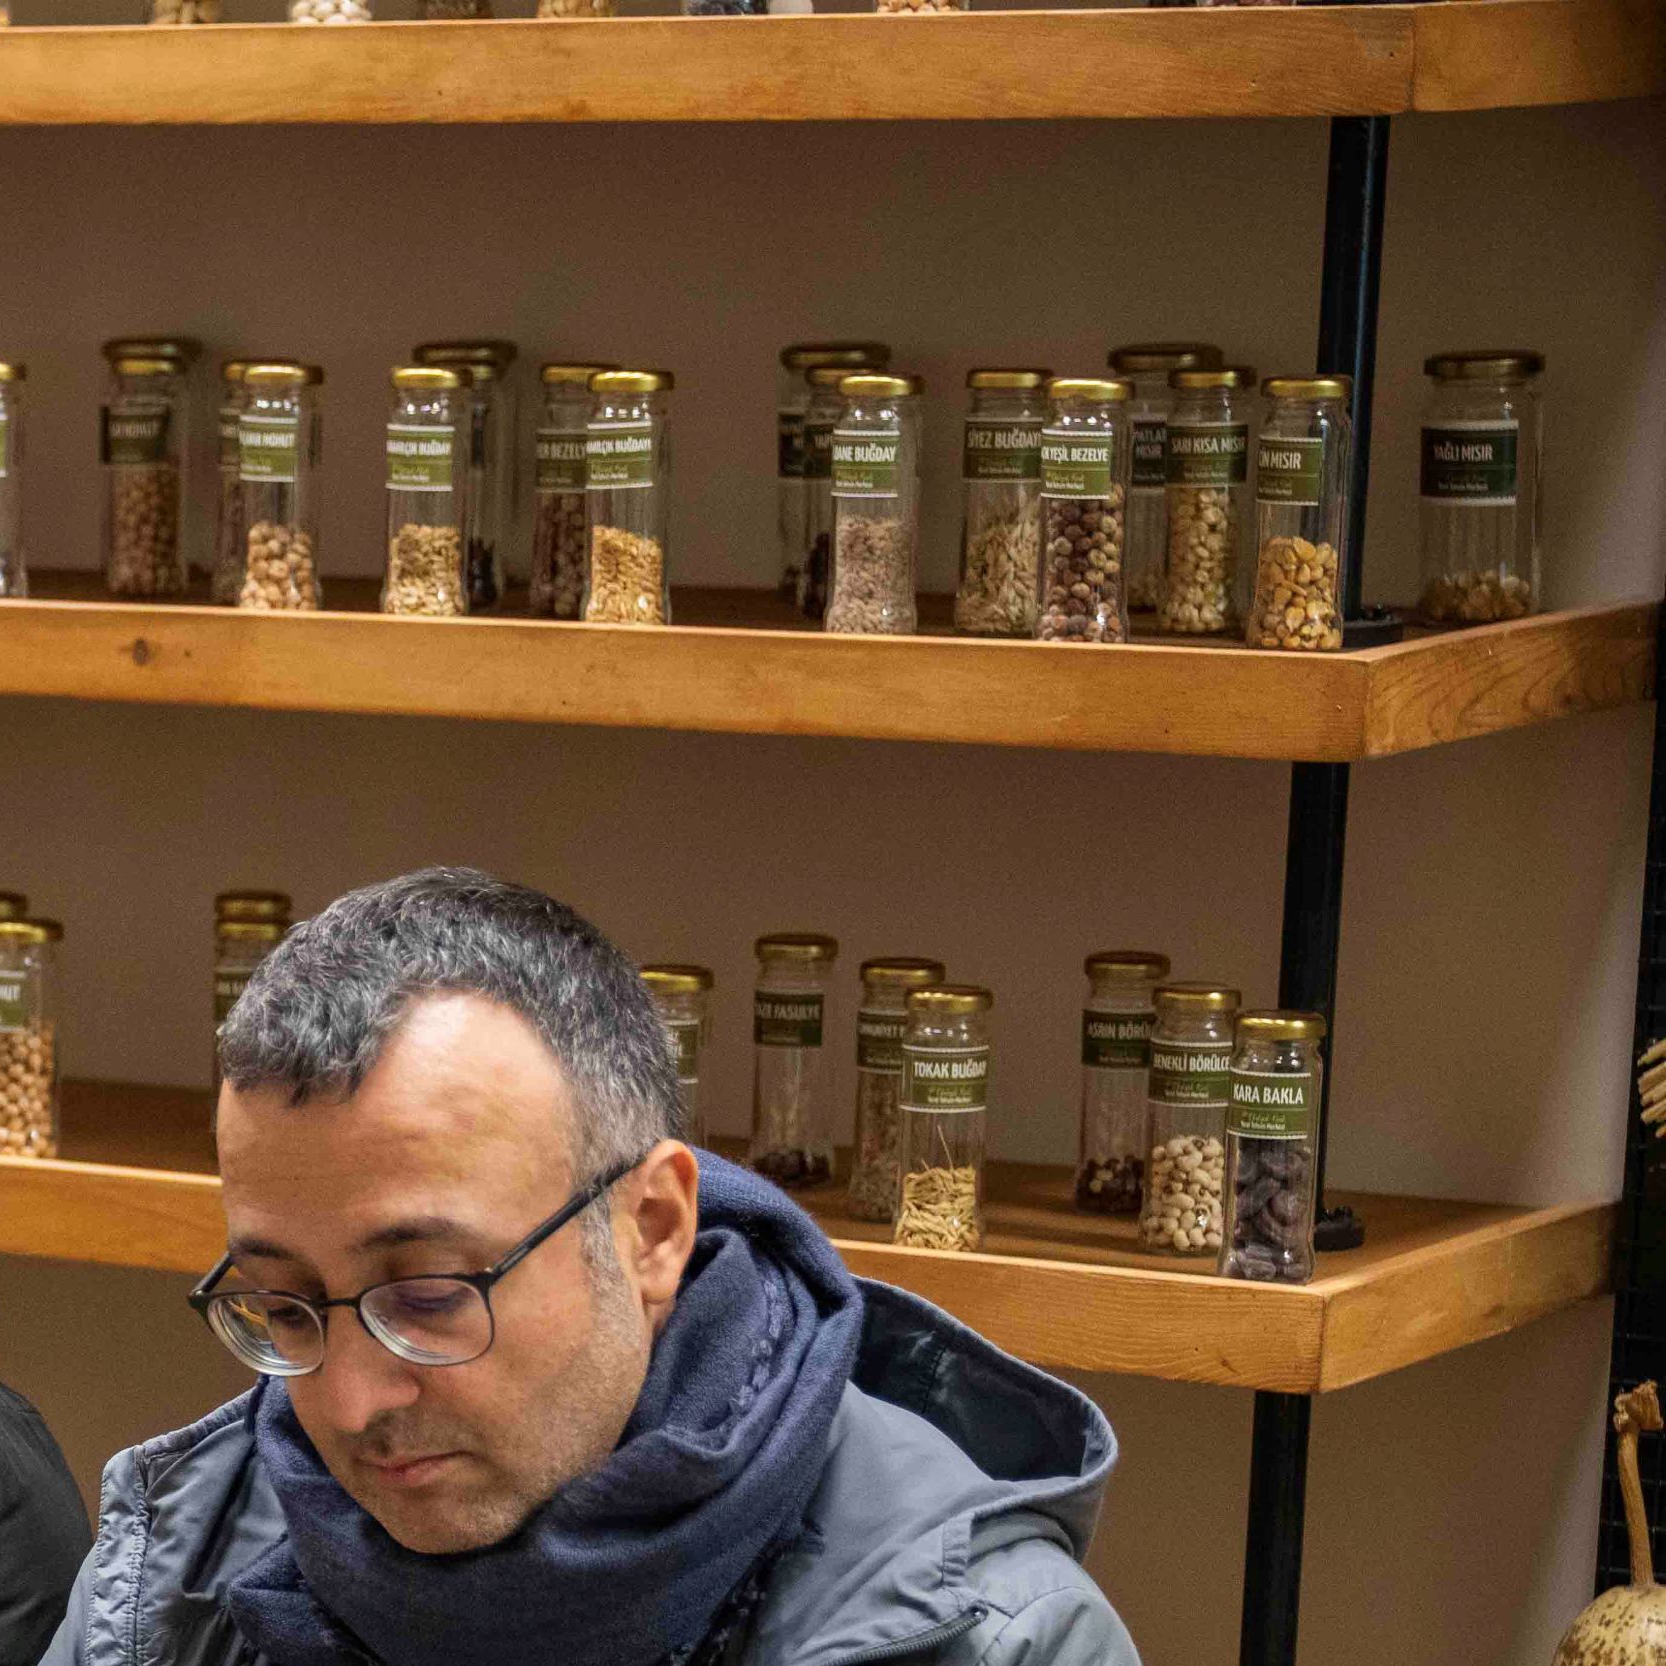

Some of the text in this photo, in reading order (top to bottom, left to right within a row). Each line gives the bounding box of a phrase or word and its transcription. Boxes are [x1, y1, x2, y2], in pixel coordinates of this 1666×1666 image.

[854, 442, 897, 462] BUĞDAY
[1071, 446, 1109, 462] BEZELYE
[1270, 450, 1302, 470] MISIR
[1461, 443, 1494, 462] MISIR
[914, 1061, 949, 1079] TOKAK
[1189, 1052, 1230, 1072] BÖRÜLCE
[1233, 1082, 1304, 1105] KARA BAKLA
